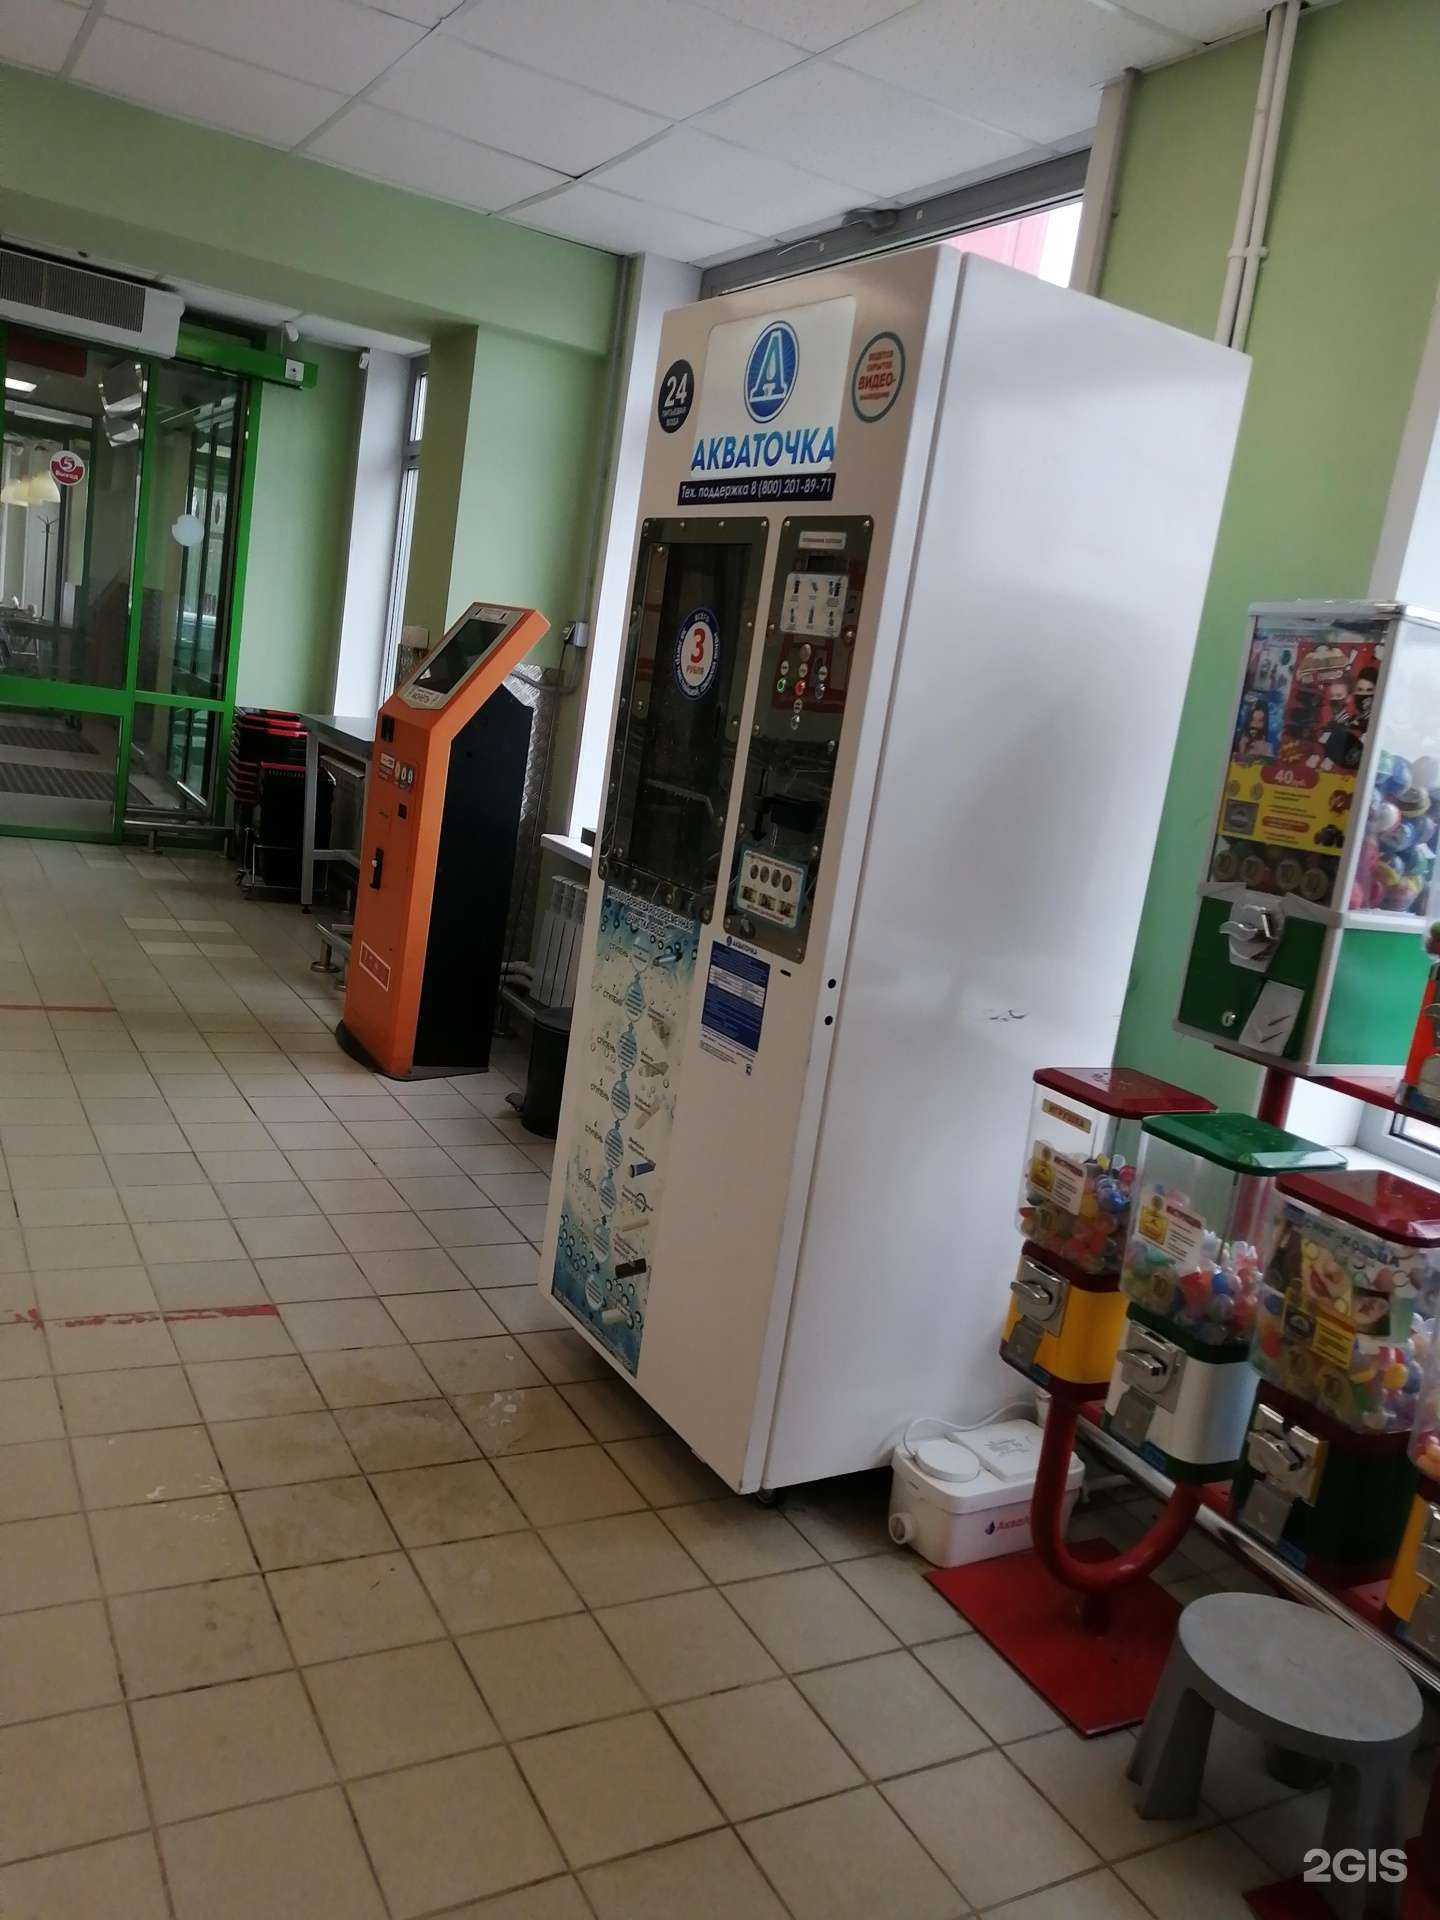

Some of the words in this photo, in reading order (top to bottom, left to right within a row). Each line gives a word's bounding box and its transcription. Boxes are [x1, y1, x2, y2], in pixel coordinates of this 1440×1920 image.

[664, 373, 688, 407] 24
[691, 426, 835, 471] АКВАТОЧКА
[681, 485, 696, 498] Тех.
[698, 484, 749, 500] поддержка
[751, 482, 757, 495] 8
[758, 479, 782, 498] (800)
[784, 478, 832, 496] 201-89-71
[690, 628, 706, 663] 3
[1274, 769, 1294, 785] 40
